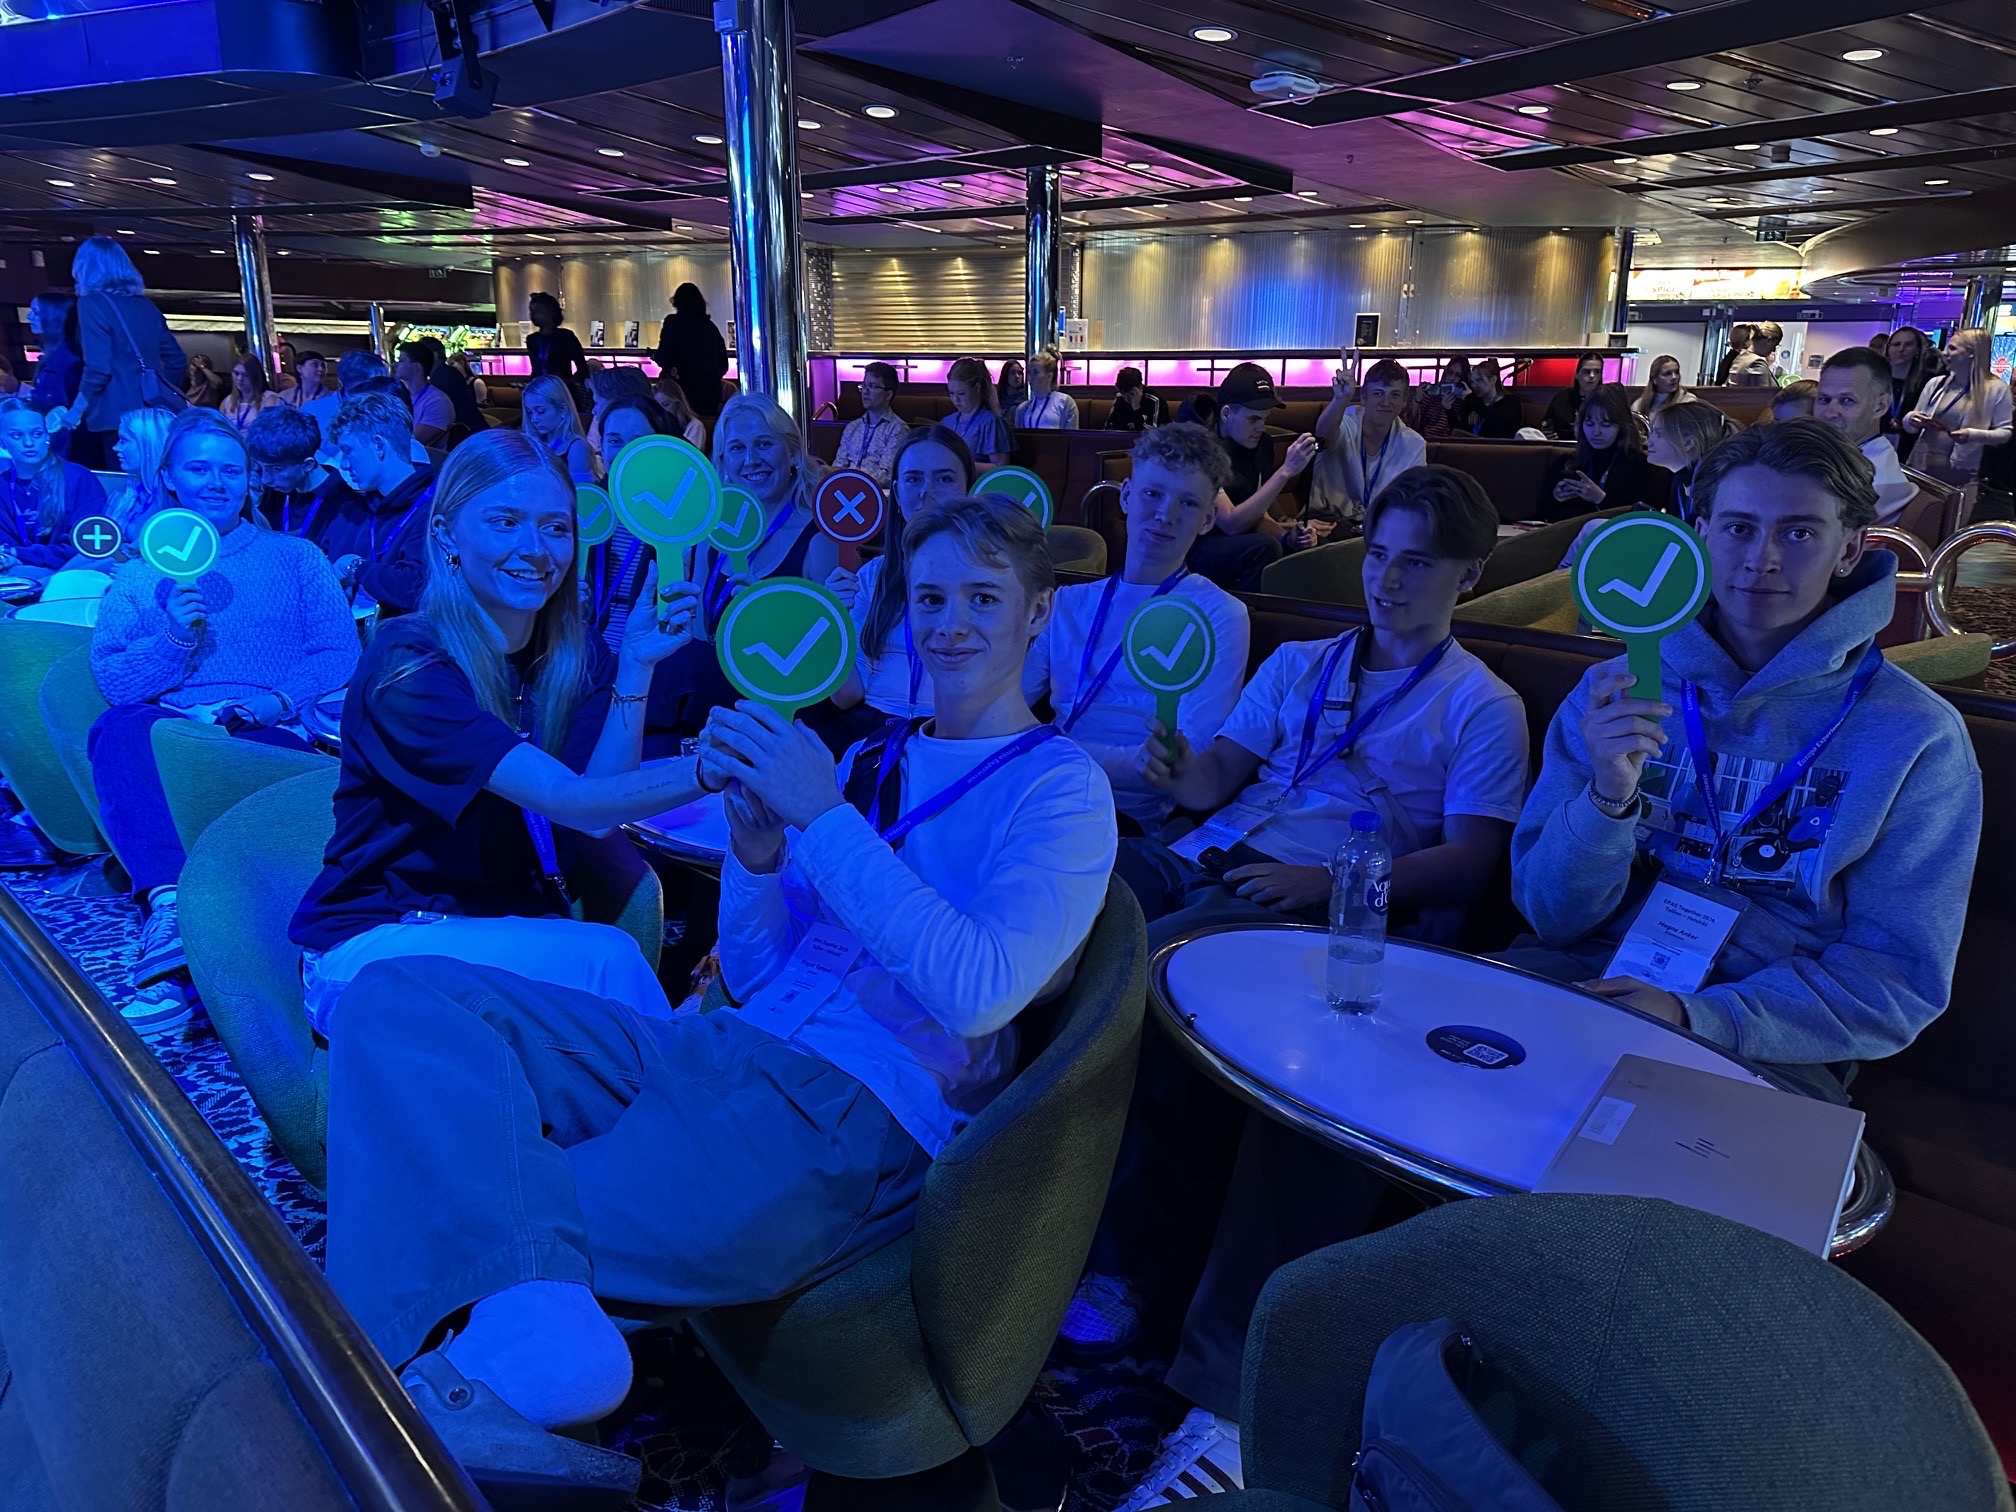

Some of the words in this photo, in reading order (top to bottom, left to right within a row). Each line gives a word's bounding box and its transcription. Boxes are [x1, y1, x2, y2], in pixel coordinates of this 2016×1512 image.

[1797, 745, 1817, 767] Europa
[1678, 904, 1702, 918] Together
[1687, 915, 1709, 927] Helsinki
[1678, 929, 1699, 940] Anker
